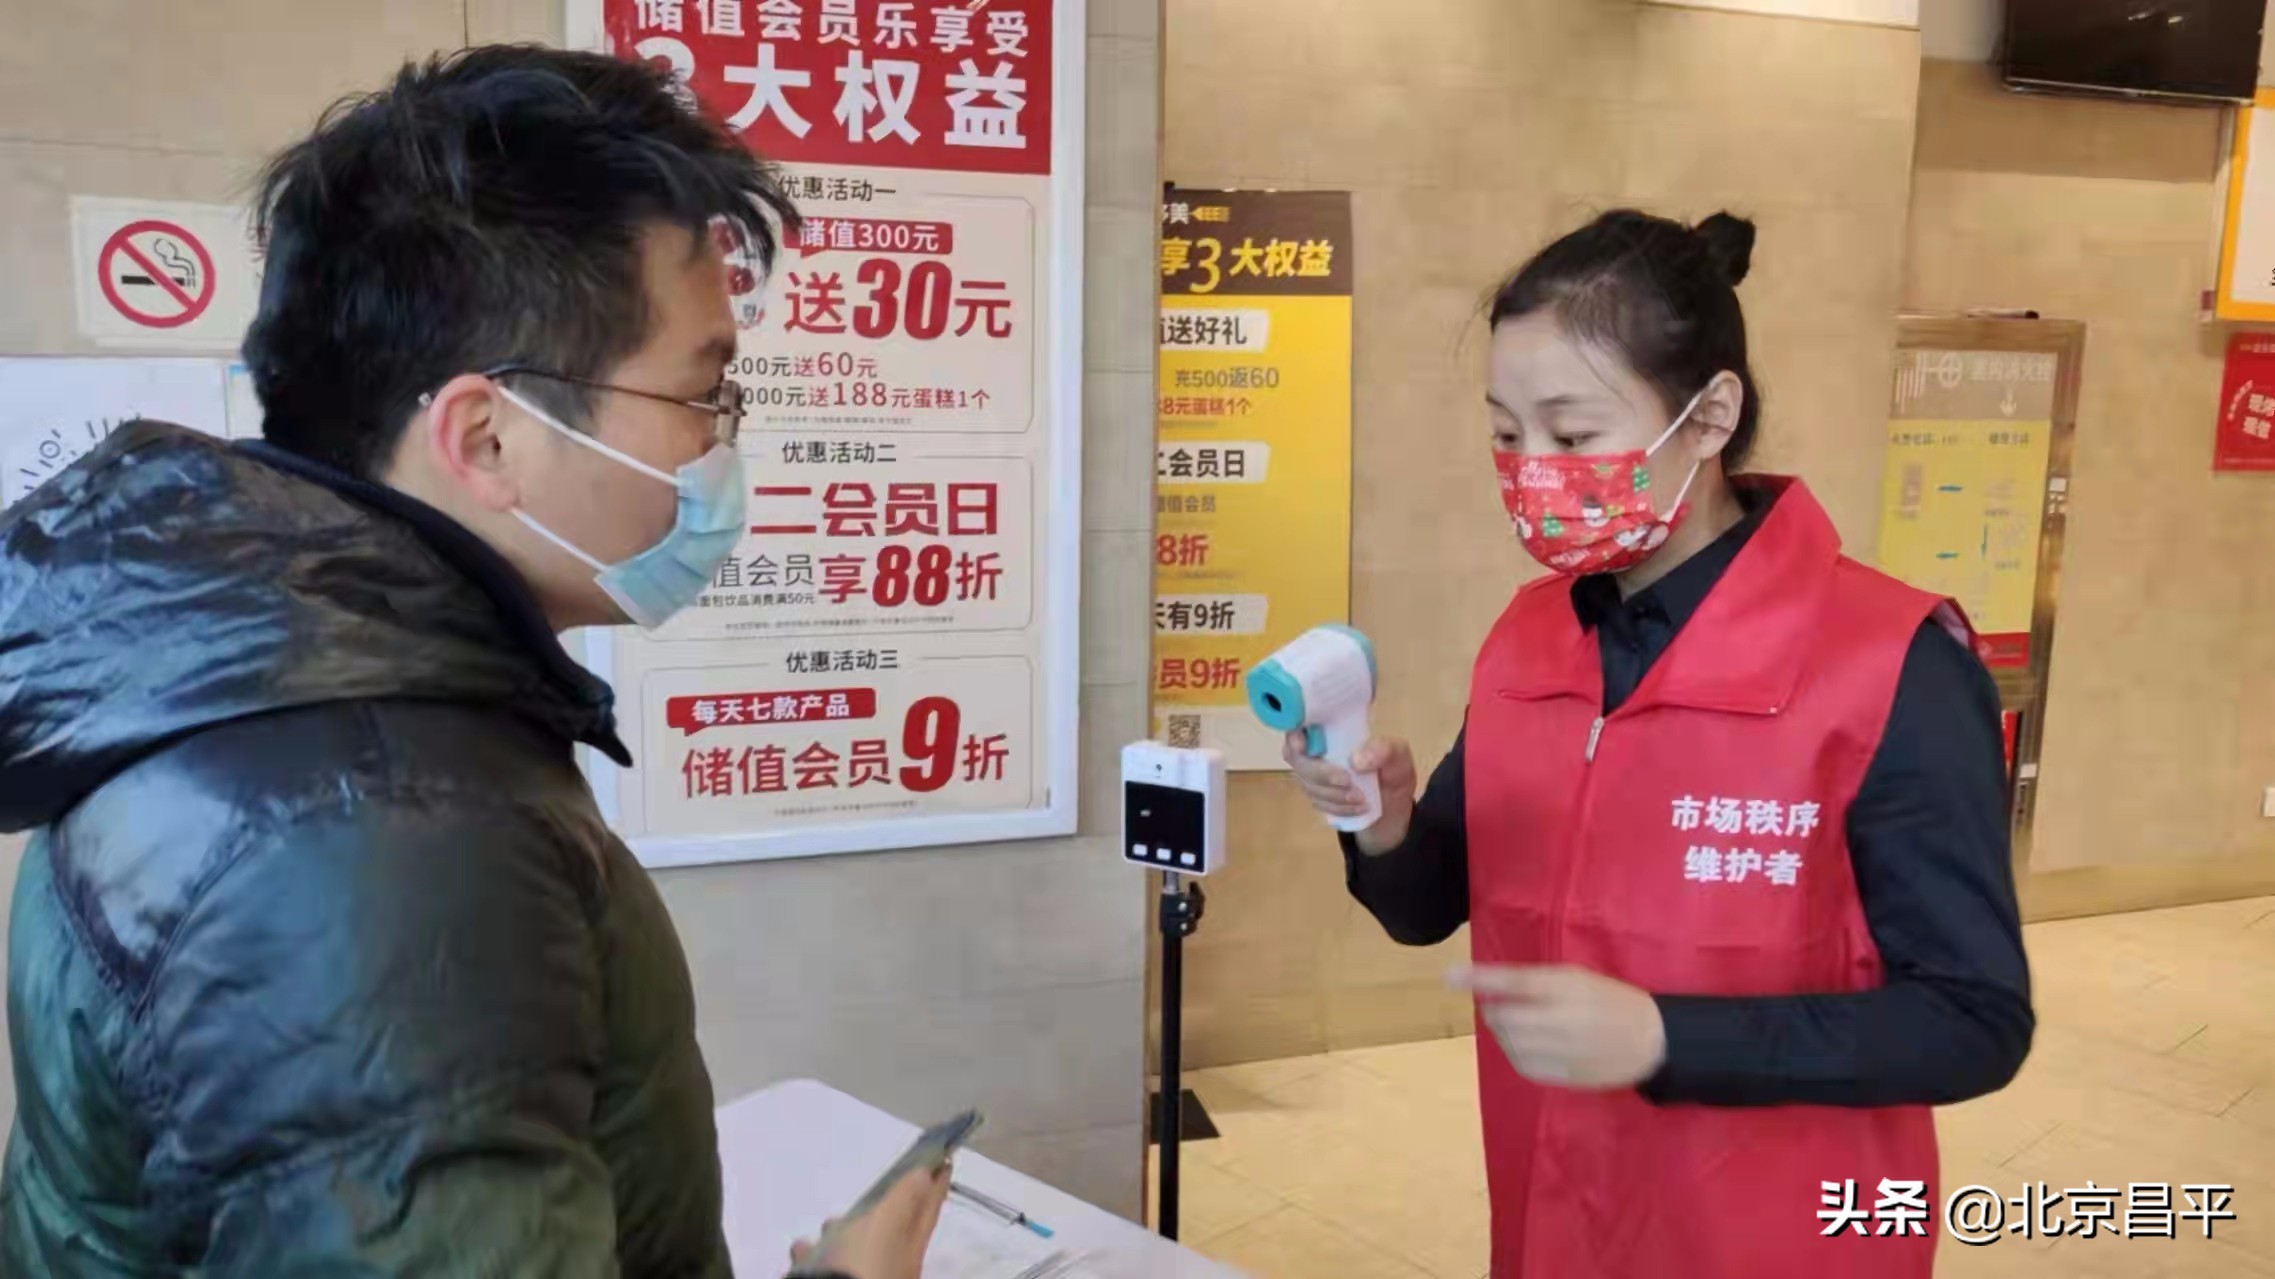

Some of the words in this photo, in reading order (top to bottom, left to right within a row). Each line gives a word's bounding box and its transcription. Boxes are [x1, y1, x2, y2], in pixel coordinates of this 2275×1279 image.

[634, 0, 1029, 58] 储值会员乐享受
[778, 175, 897, 203] 优惠活动一
[800, 219, 940, 251] 储值300元
[1161, 237, 1333, 293] 享3大权益
[783, 258, 1013, 340] 送30元
[1175, 367, 1279, 388] 充500返60
[781, 440, 898, 464] 优惠活动二
[750, 482, 998, 538] 二会员日
[786, 648, 899, 674] 优惠活动三
[691, 694, 850, 725] 每天七款产品
[681, 696, 1010, 801] 储值会员9折
[1672, 795, 1820, 838] 市场秩序
[1684, 845, 1803, 886] 维护者
